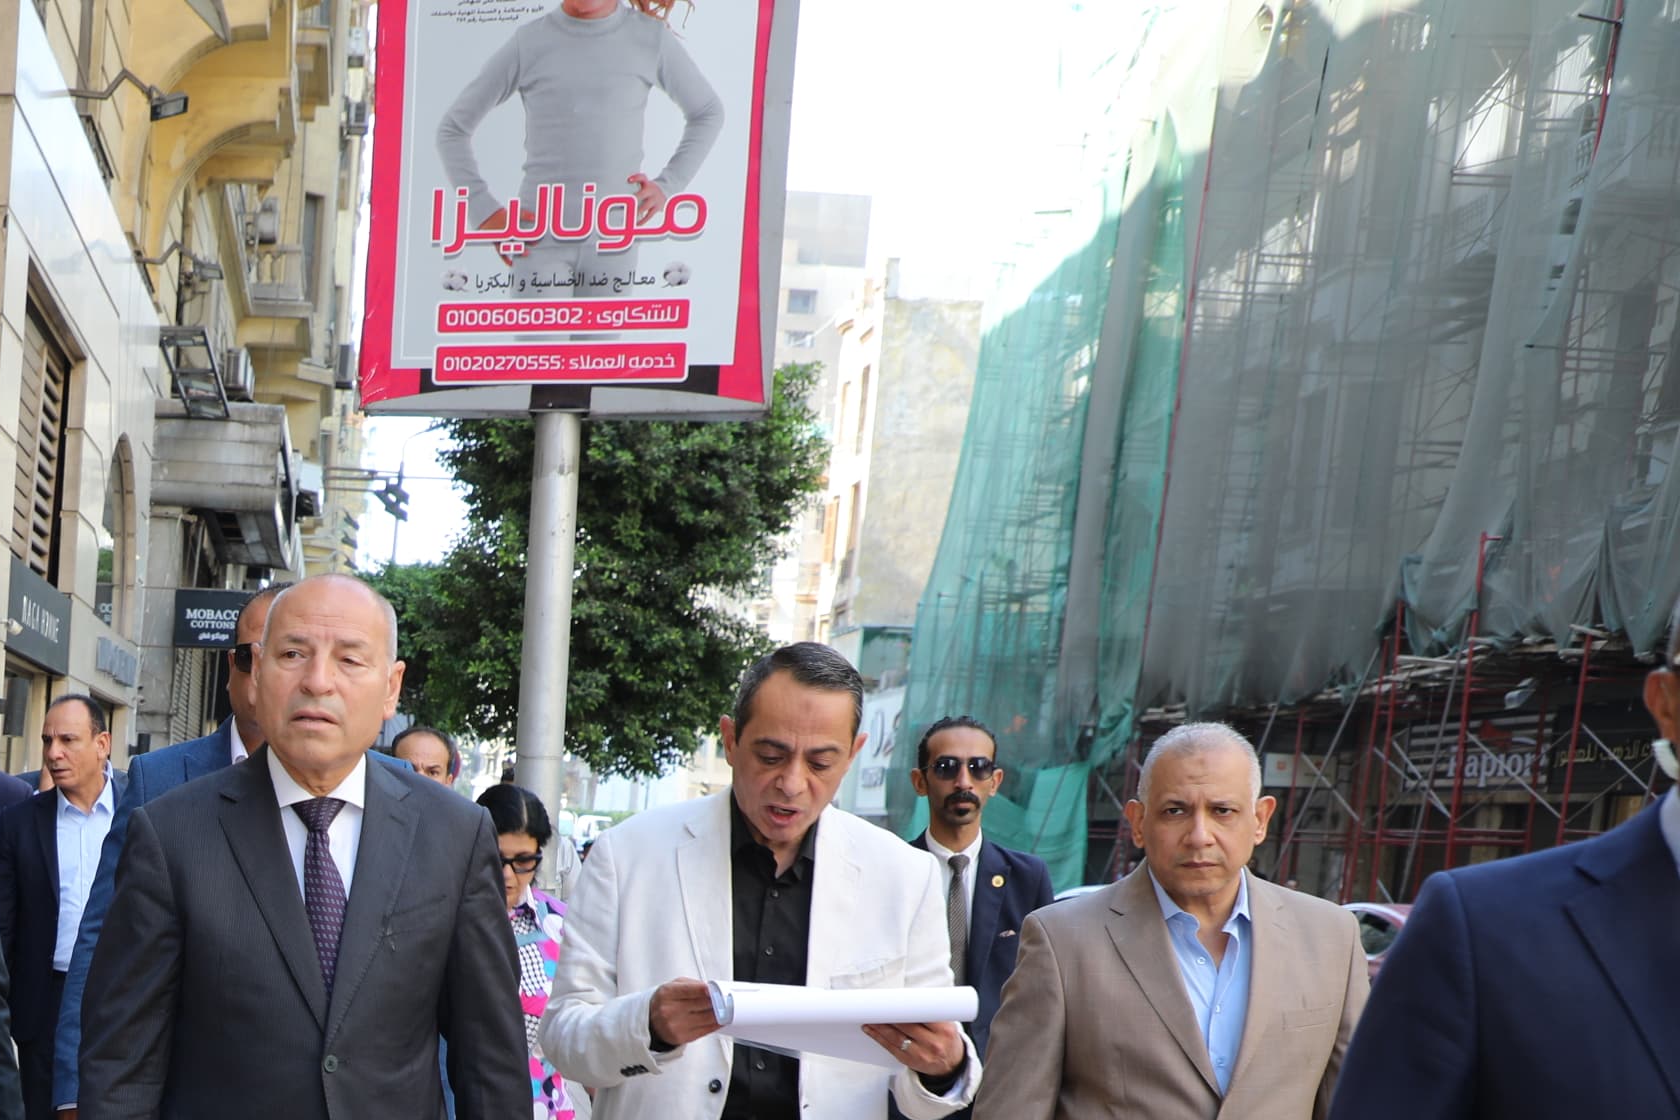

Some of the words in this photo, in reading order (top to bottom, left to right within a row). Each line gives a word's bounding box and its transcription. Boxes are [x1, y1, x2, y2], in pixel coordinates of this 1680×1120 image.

[431, 184, 708, 254] موناليزا
[475, 272, 515, 294] البكتريا
[519, 279, 525, 292] و
[530, 272, 585, 293] الحساسية
[589, 273, 609, 288] ضد
[612, 272, 656, 293] معالج
[445, 307, 583, 327] 01006060302
[596, 303, 681, 327] للشكاوى
[569, 353, 625, 370] العملاء
[190, 620, 236, 630] COTTONS
